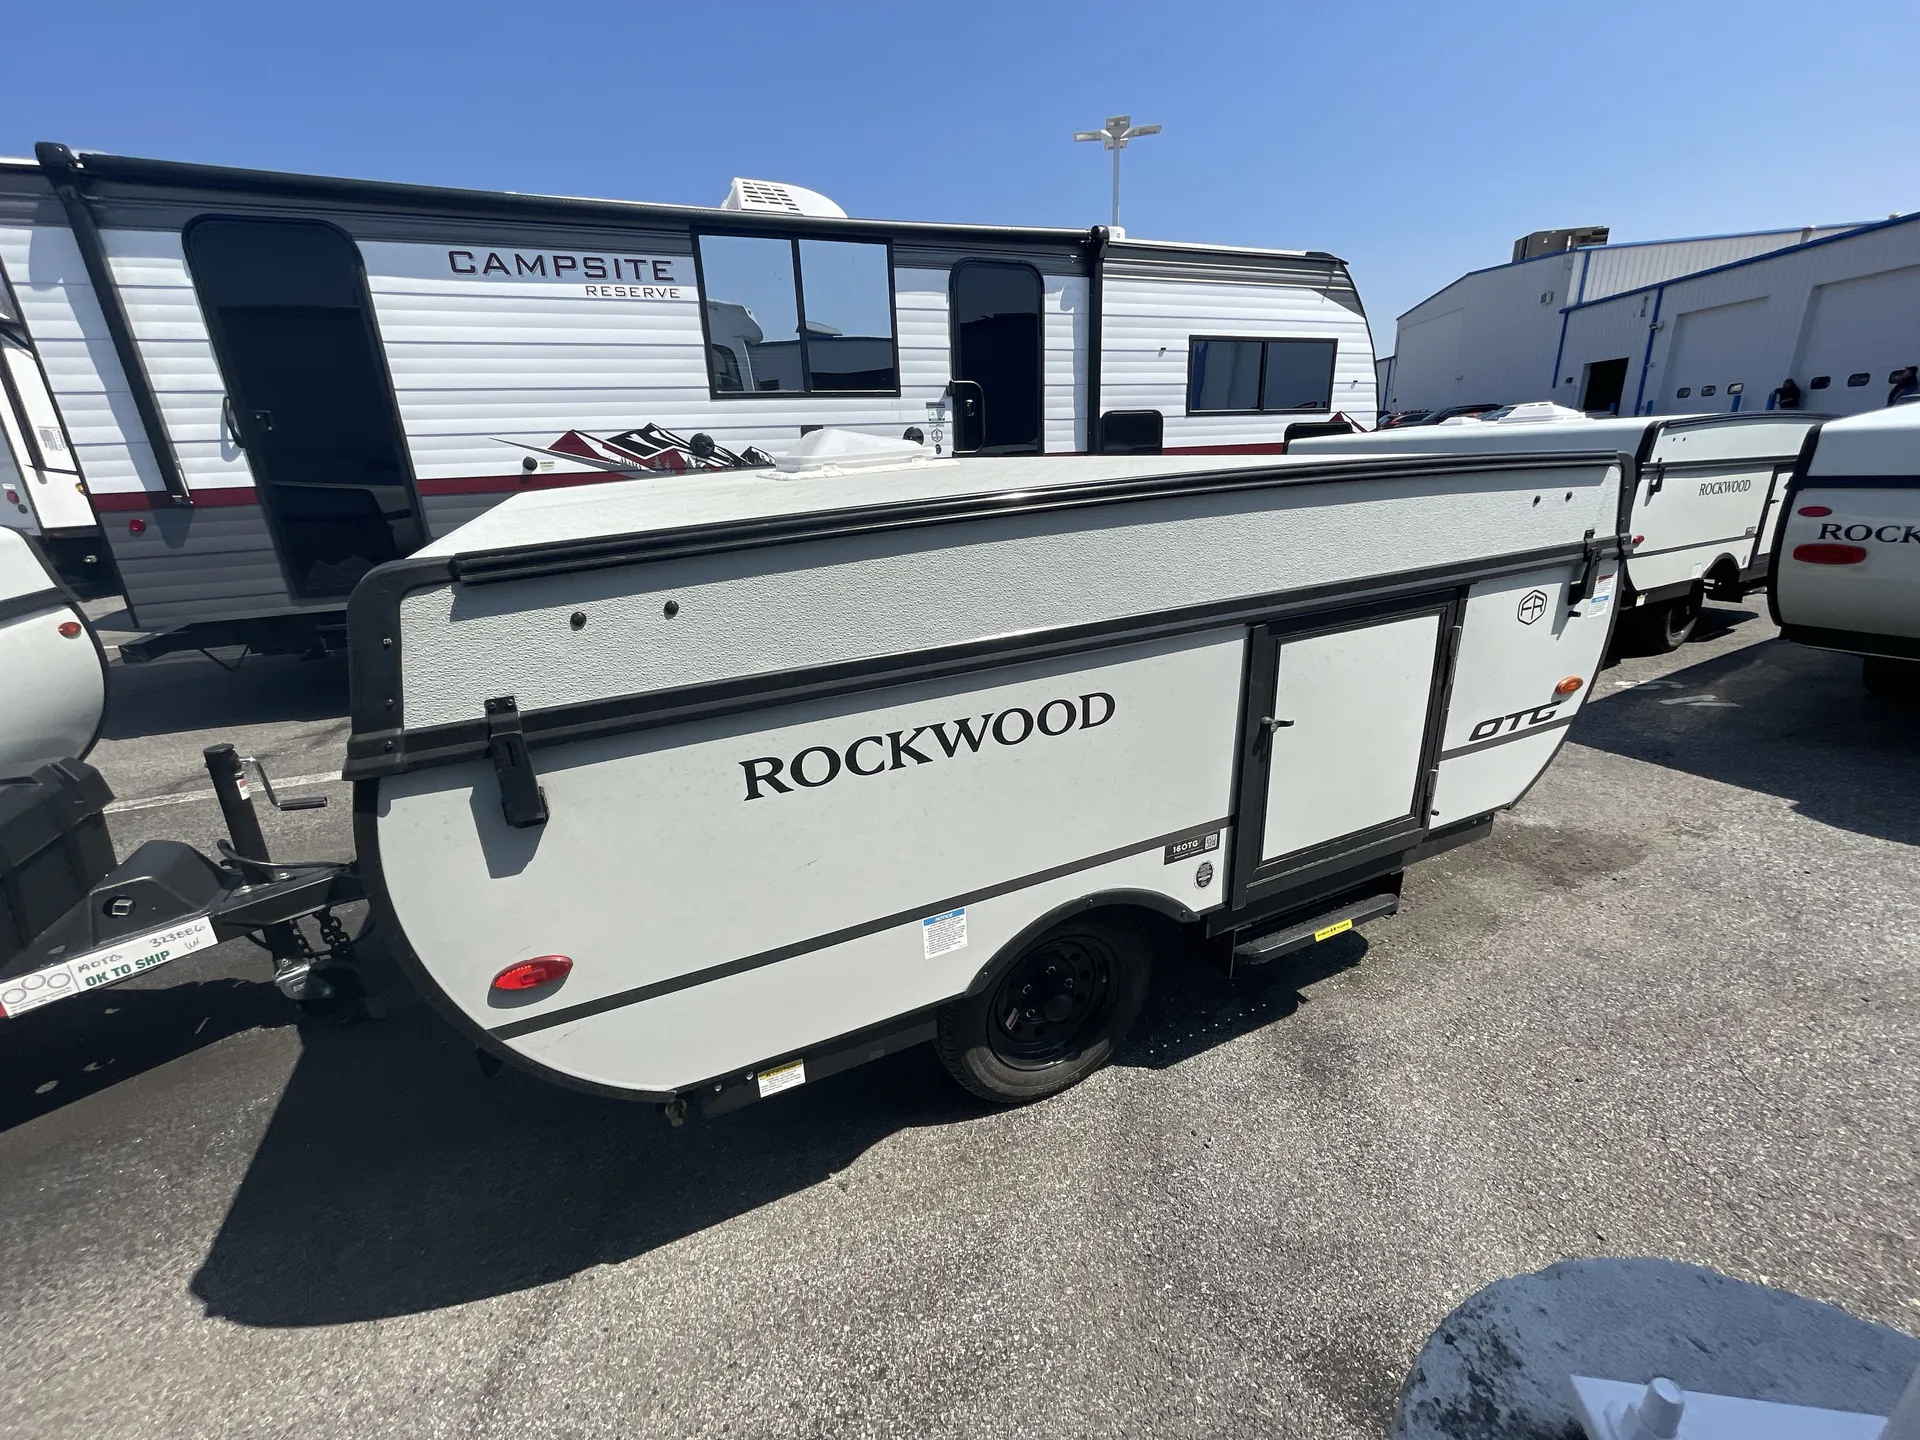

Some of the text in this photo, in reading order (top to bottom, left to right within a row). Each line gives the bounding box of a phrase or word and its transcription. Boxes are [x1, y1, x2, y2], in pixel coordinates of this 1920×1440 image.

[448, 250, 676, 282] CAMPSITE
[585, 284, 681, 299] RESERVE
[1698, 480, 1752, 496] ROCKWOOD
[1468, 699, 1563, 742] OTG
[738, 691, 1116, 801] ROCKWOOD
[85, 950, 170, 987] OK TO SHIP
